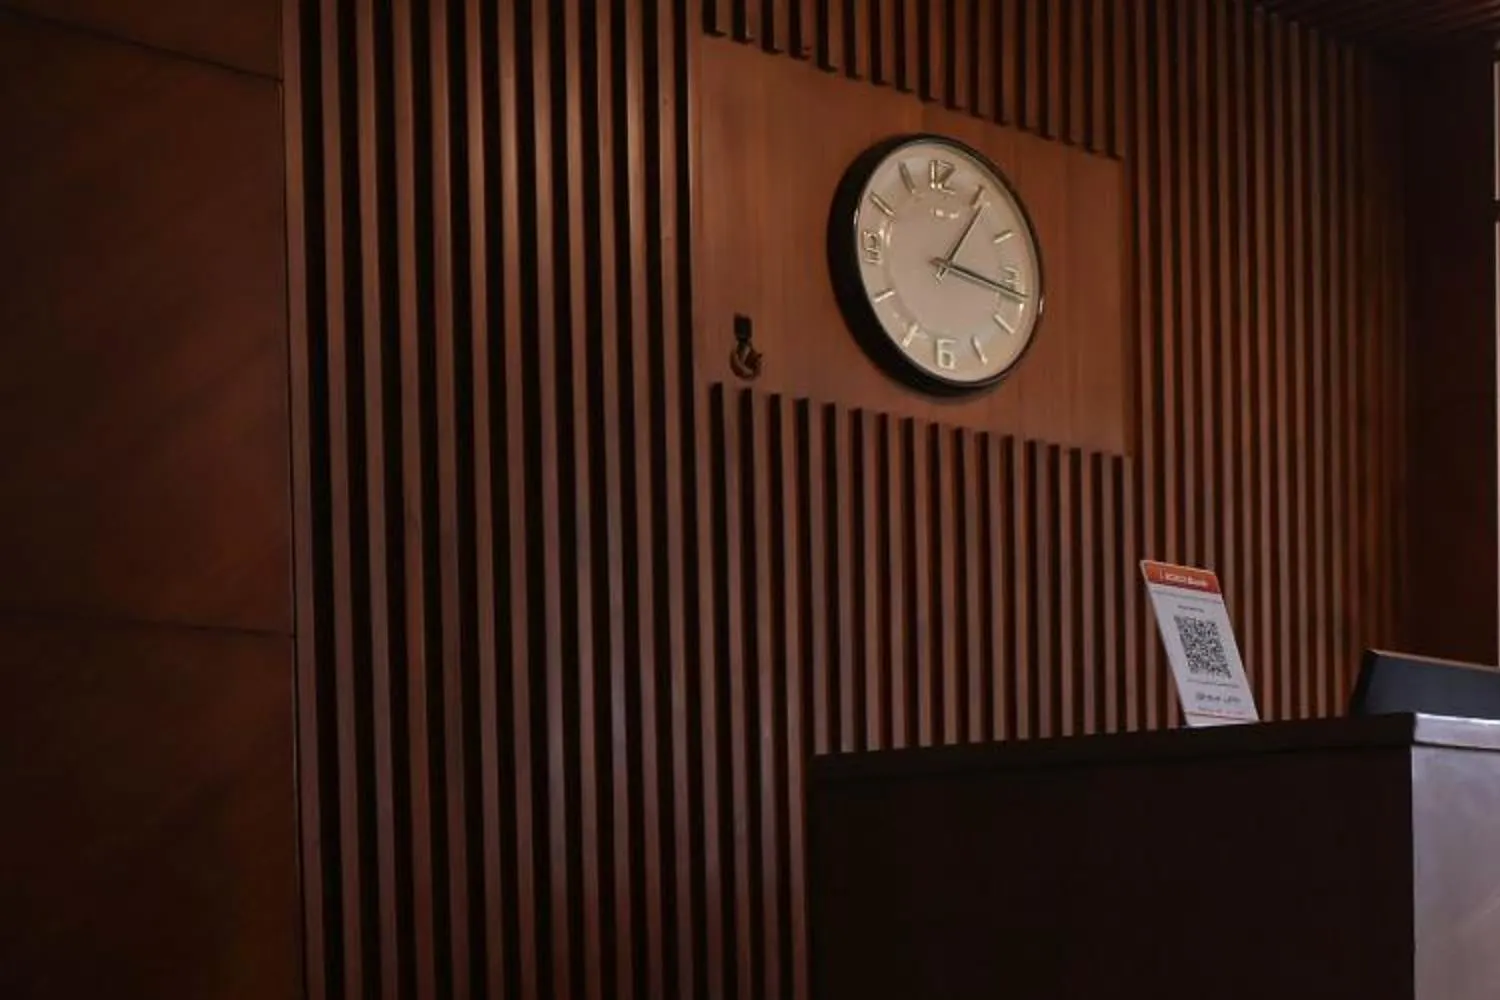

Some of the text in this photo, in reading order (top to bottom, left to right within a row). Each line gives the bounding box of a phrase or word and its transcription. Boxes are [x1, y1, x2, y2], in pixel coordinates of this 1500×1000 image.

[930, 160, 955, 194] 12
[864, 231, 882, 264] 9
[936, 338, 956, 369] 6
